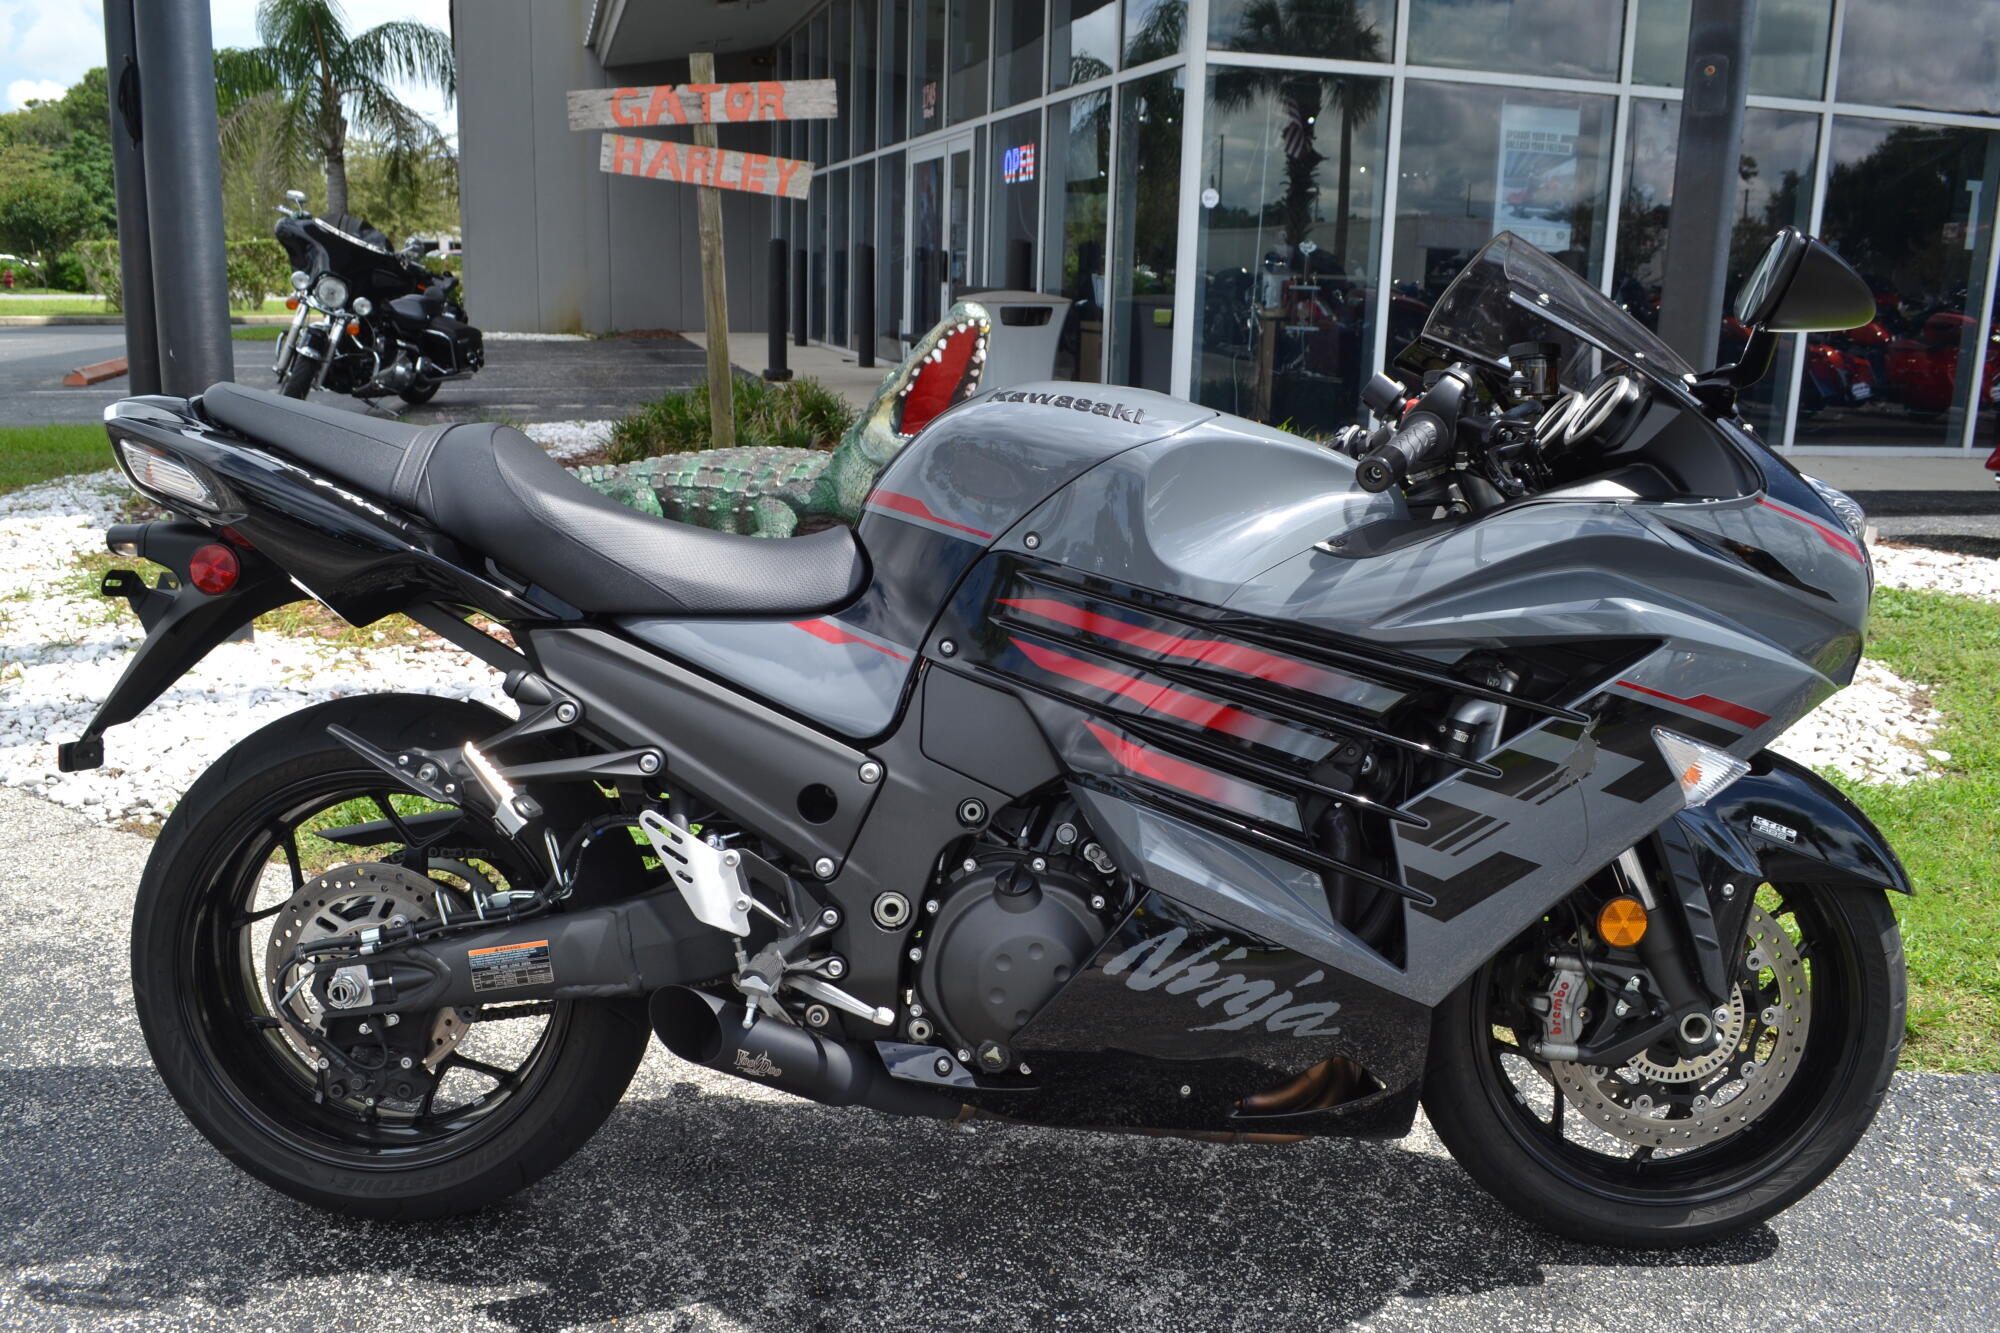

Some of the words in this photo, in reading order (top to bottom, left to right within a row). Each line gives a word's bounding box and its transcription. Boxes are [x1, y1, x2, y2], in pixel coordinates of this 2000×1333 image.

[610, 81, 789, 127] GATOR
[612, 135, 799, 196] HARLEY
[1004, 143, 1035, 184] OPEN
[985, 389, 1147, 425] Kawasaki
[1102, 926, 1342, 1037] Ninja
[1550, 981, 1570, 1035] brembo
